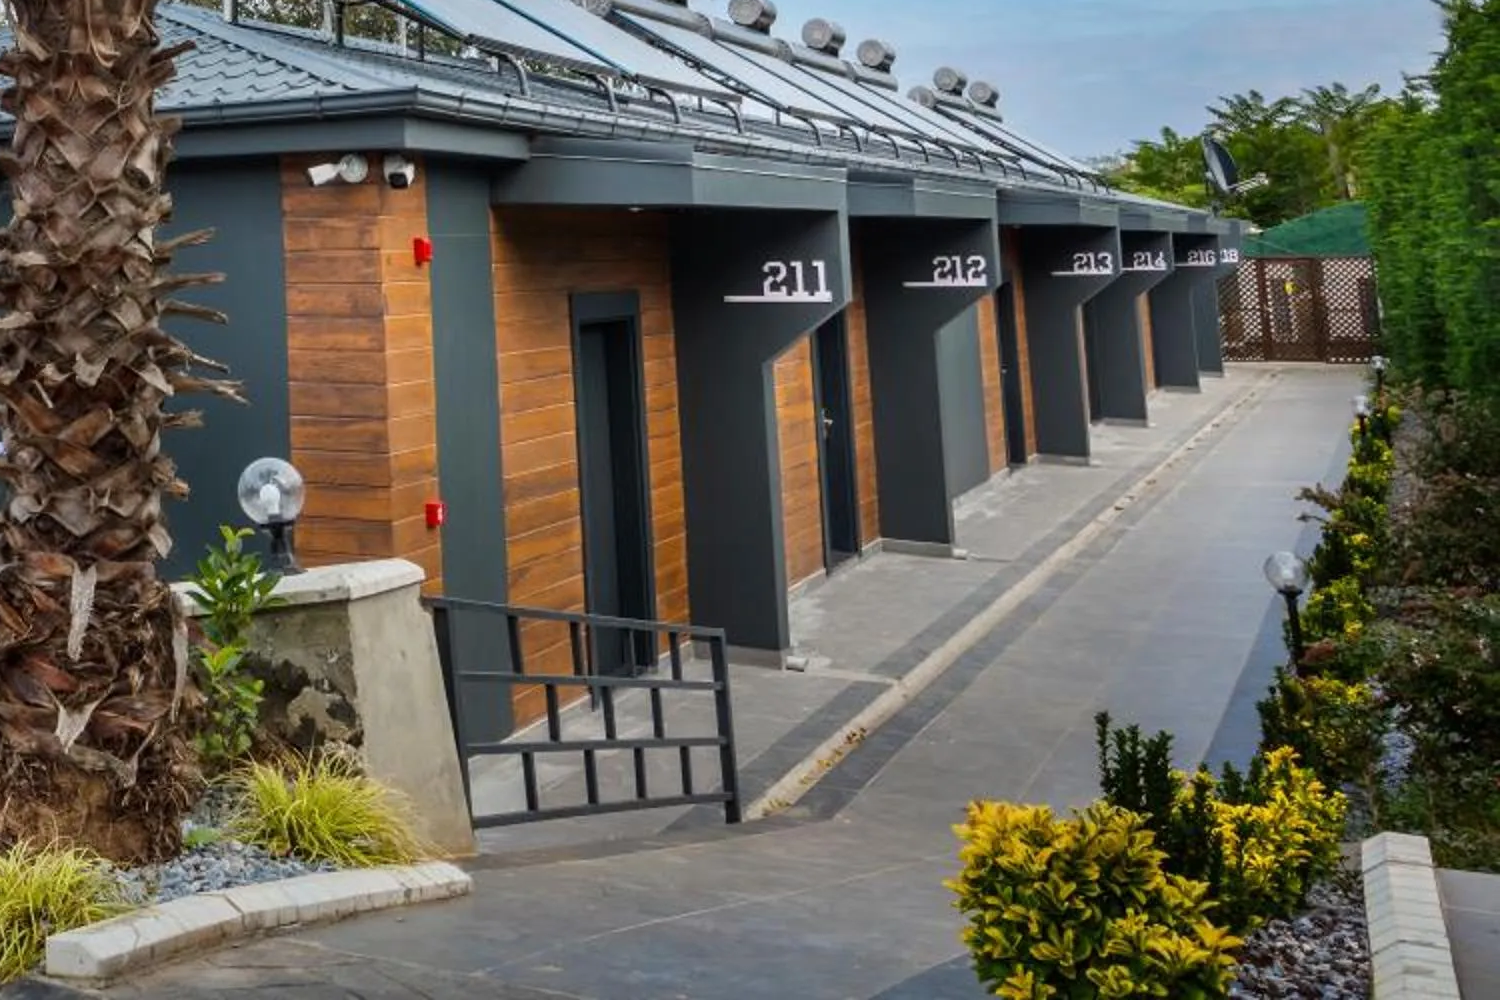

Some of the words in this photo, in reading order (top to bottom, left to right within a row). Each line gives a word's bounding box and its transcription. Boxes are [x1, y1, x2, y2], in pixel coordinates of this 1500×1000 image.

[932, 255, 987, 286] 212
[1073, 252, 1113, 274] 213
[1133, 251, 1167, 271] 214
[762, 260, 832, 302] 211
